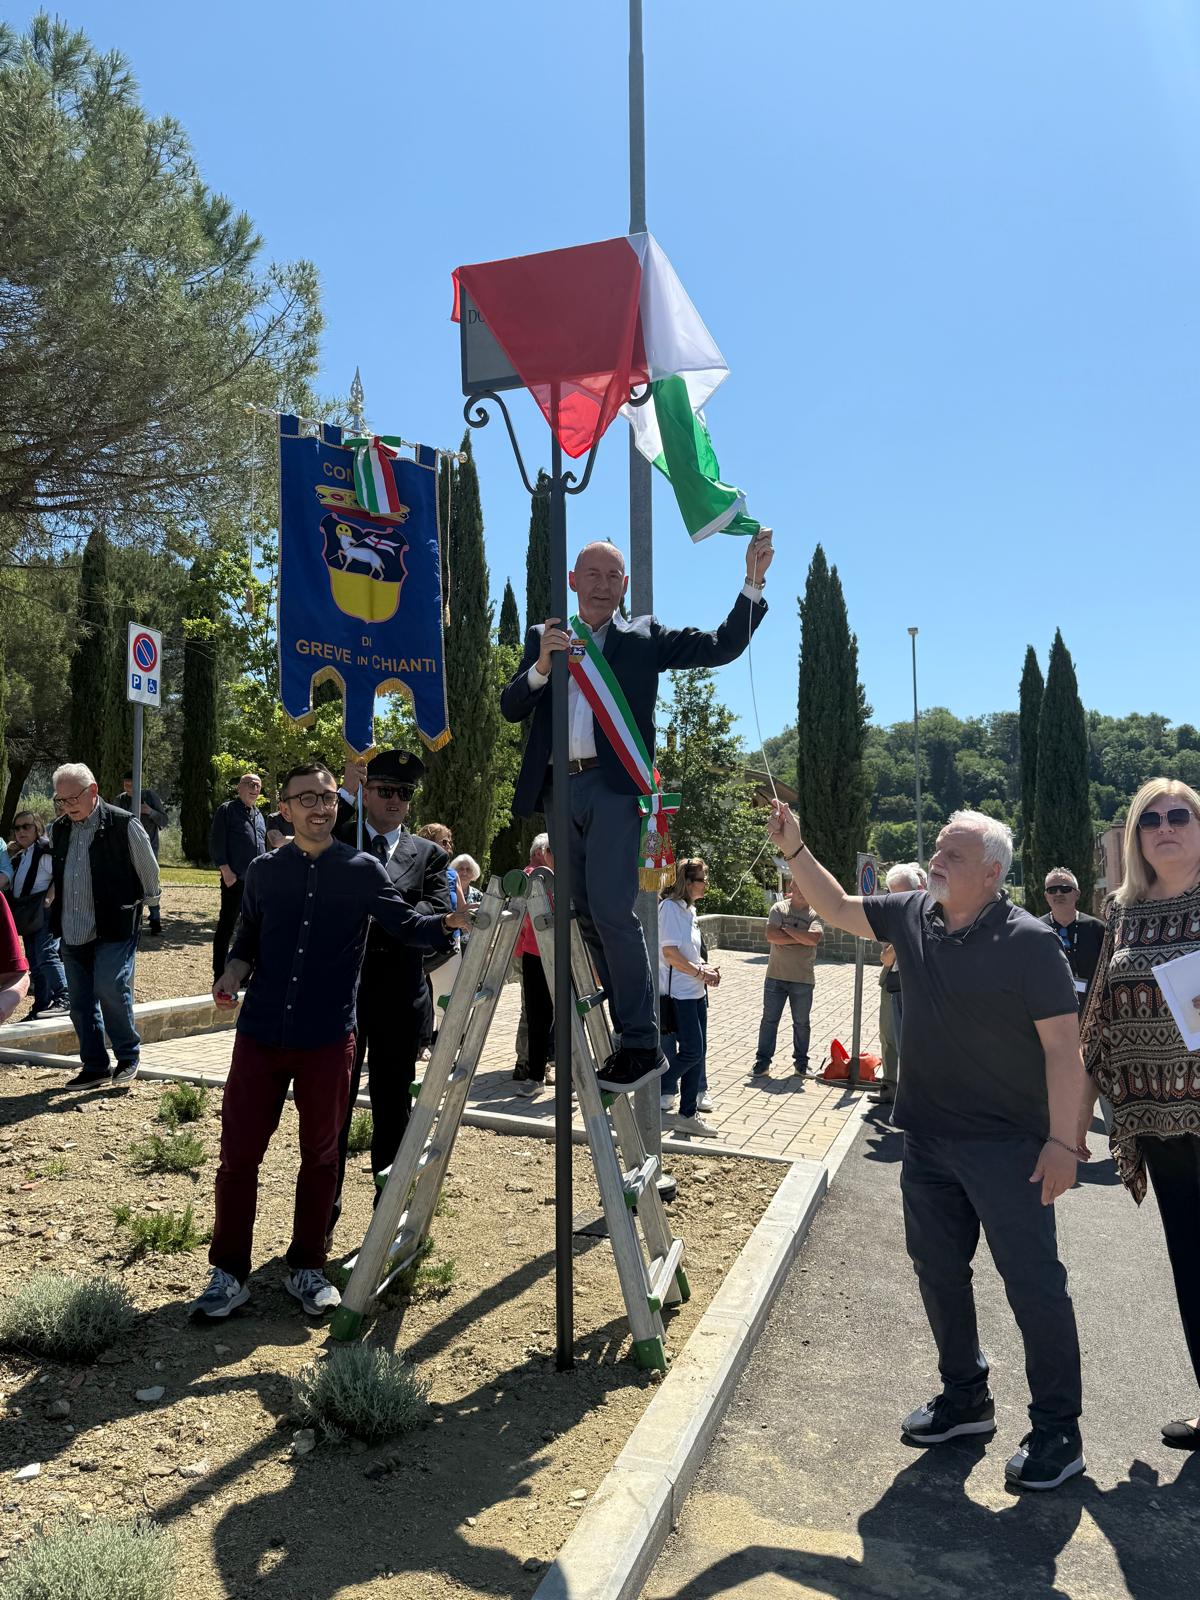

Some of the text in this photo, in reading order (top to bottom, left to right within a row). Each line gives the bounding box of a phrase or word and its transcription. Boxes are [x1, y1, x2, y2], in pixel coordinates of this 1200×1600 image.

[361, 636, 372, 647] DI
[296, 639, 436, 673] GREVE IN CHIANTI
